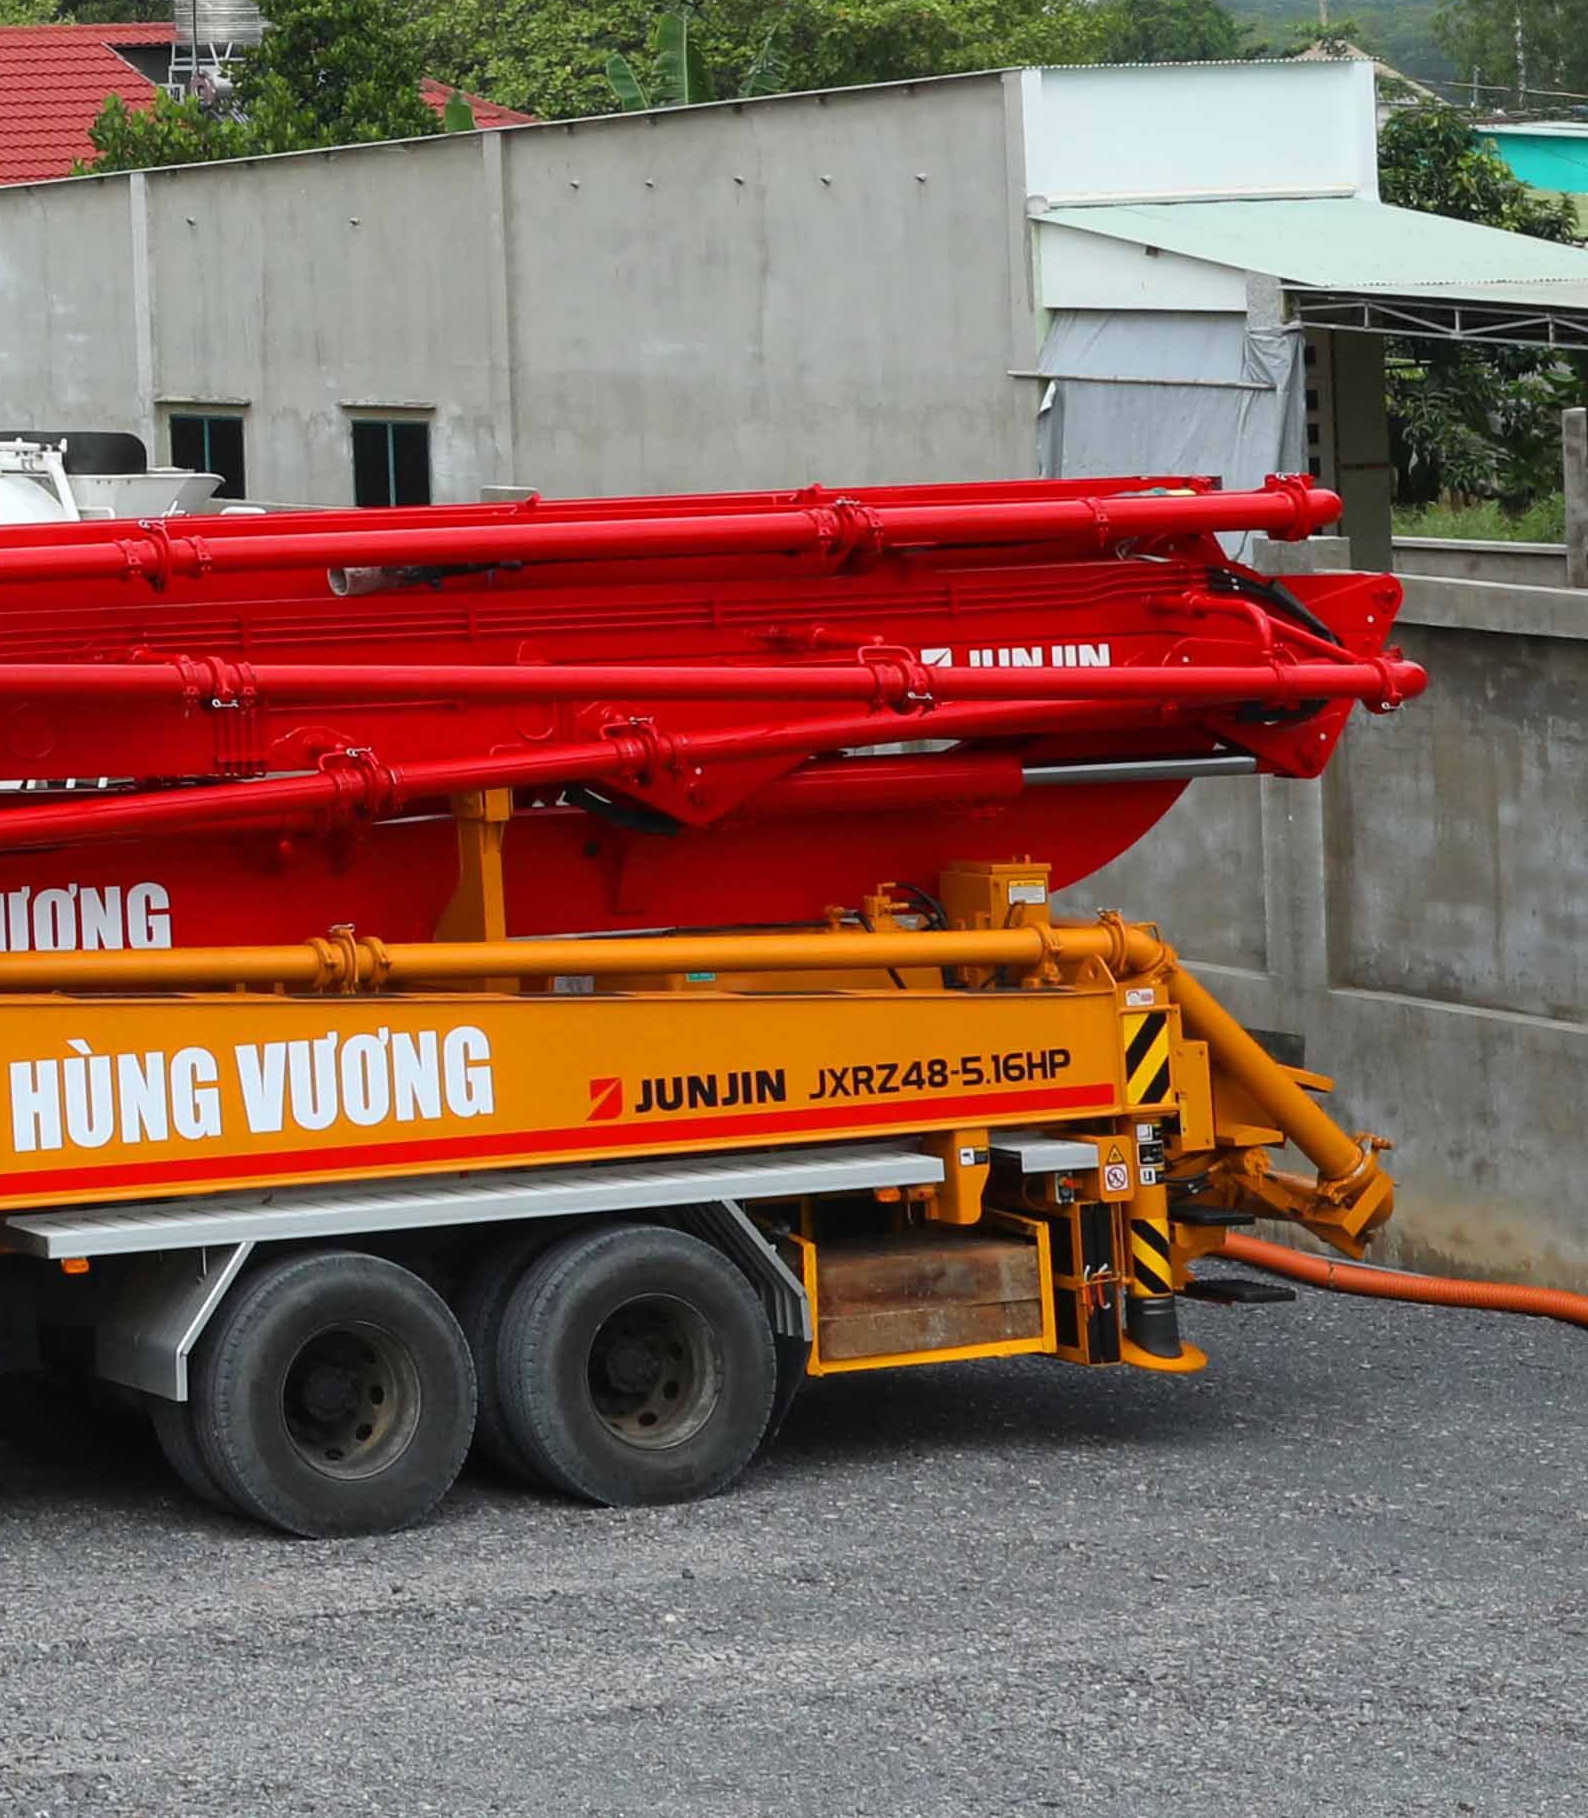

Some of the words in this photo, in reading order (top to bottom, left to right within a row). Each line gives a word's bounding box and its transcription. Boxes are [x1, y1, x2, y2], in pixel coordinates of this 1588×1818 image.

[9, 1038, 223, 1153] HÙNG
[234, 1025, 495, 1135] VƯƠNG
[635, 1068, 787, 1114] JUNJIN
[808, 1048, 1072, 1101] JXRZ48-5.16HP
